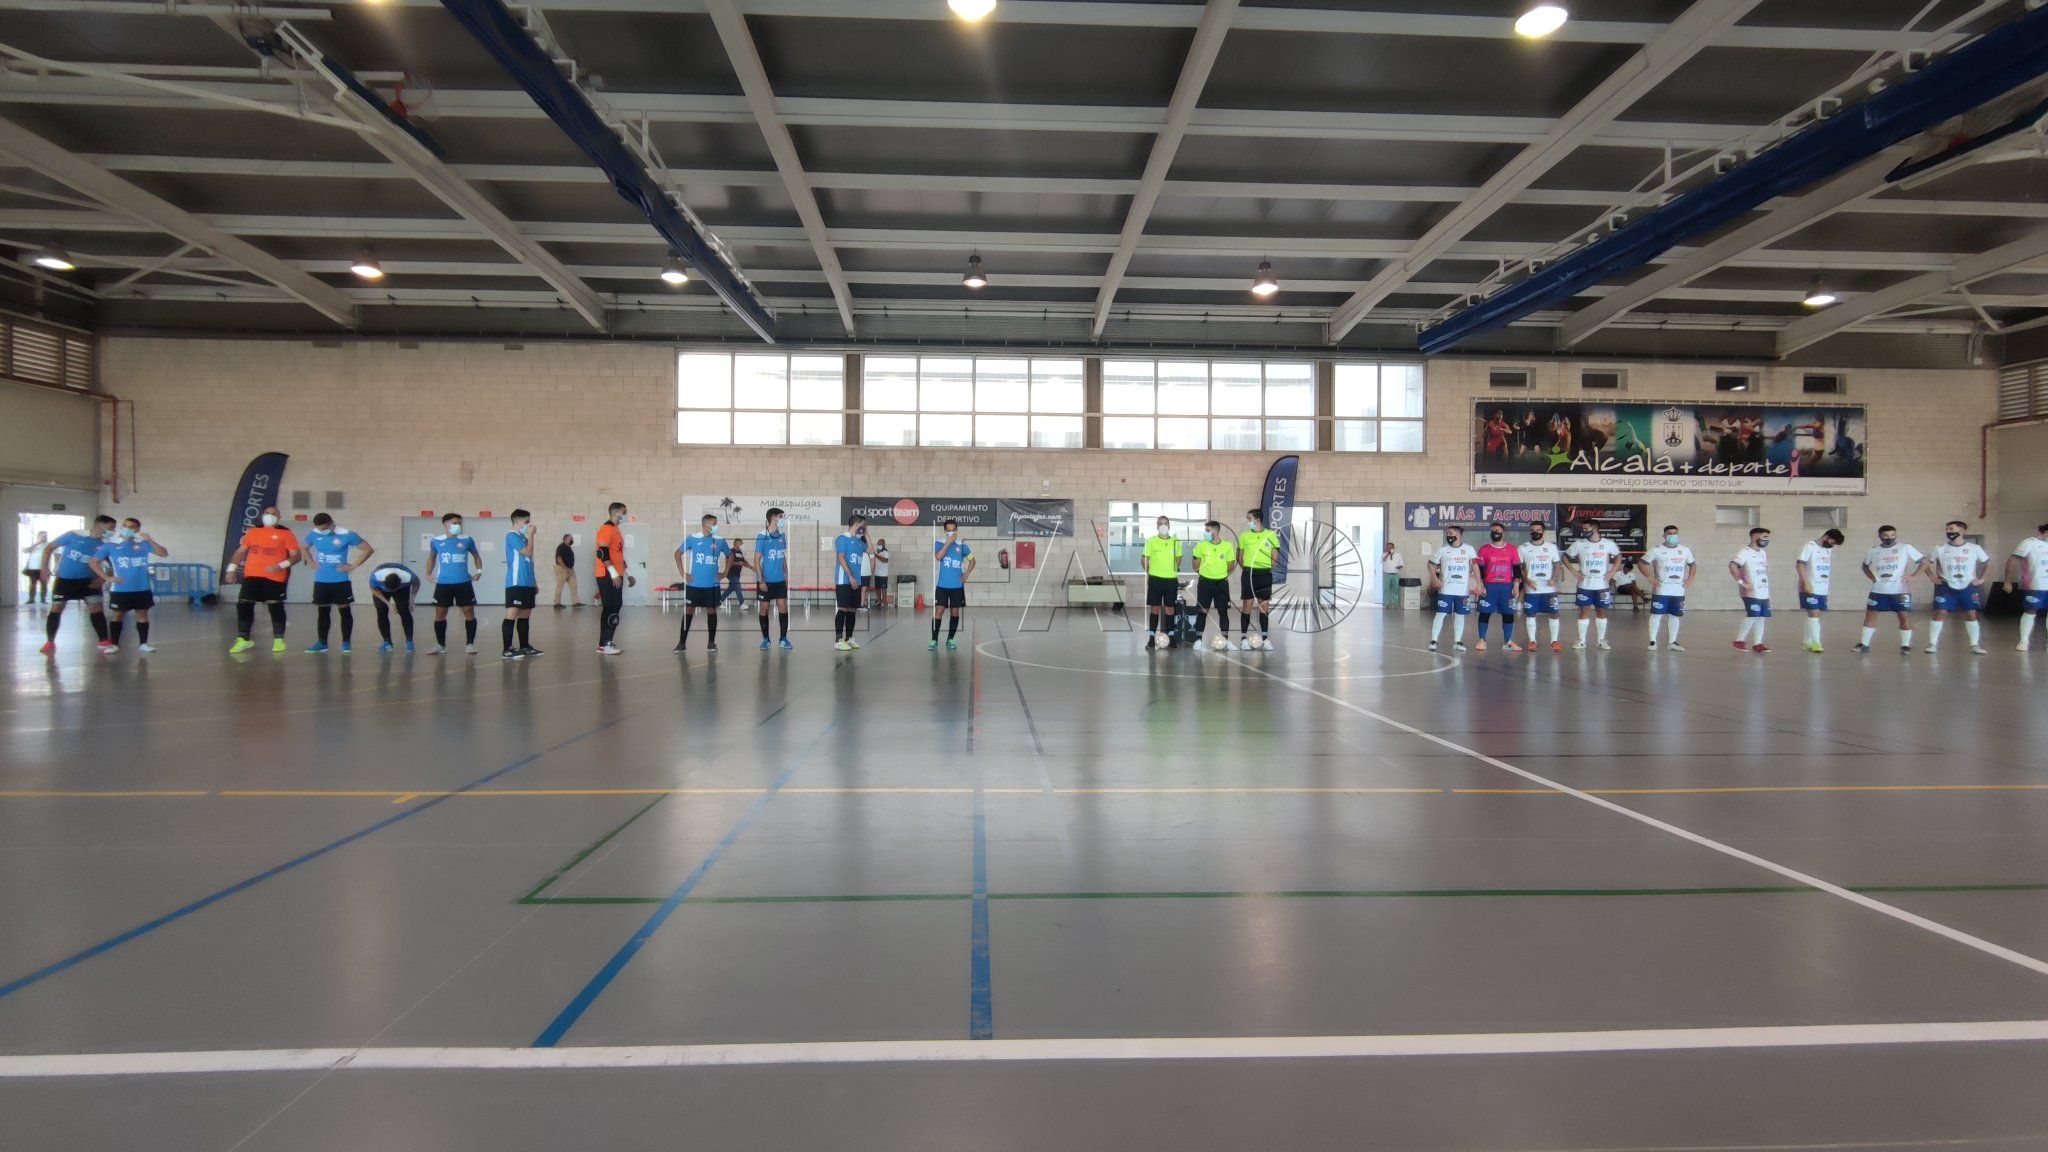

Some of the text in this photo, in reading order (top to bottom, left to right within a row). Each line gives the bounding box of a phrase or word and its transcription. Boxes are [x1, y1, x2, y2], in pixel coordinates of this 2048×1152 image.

[1570, 447, 1790, 477] Alcalá + deporte
[1600, 478, 1641, 487] COMPLEJO
[1643, 478, 1687, 487] DEPORTIVO
[760, 499, 822, 510] Malaspulgas
[931, 504, 988, 512] EQUIPAMIENTO
[1482, 505, 1552, 521] FACTORY
[937, 515, 980, 523] DEPORTIVO
